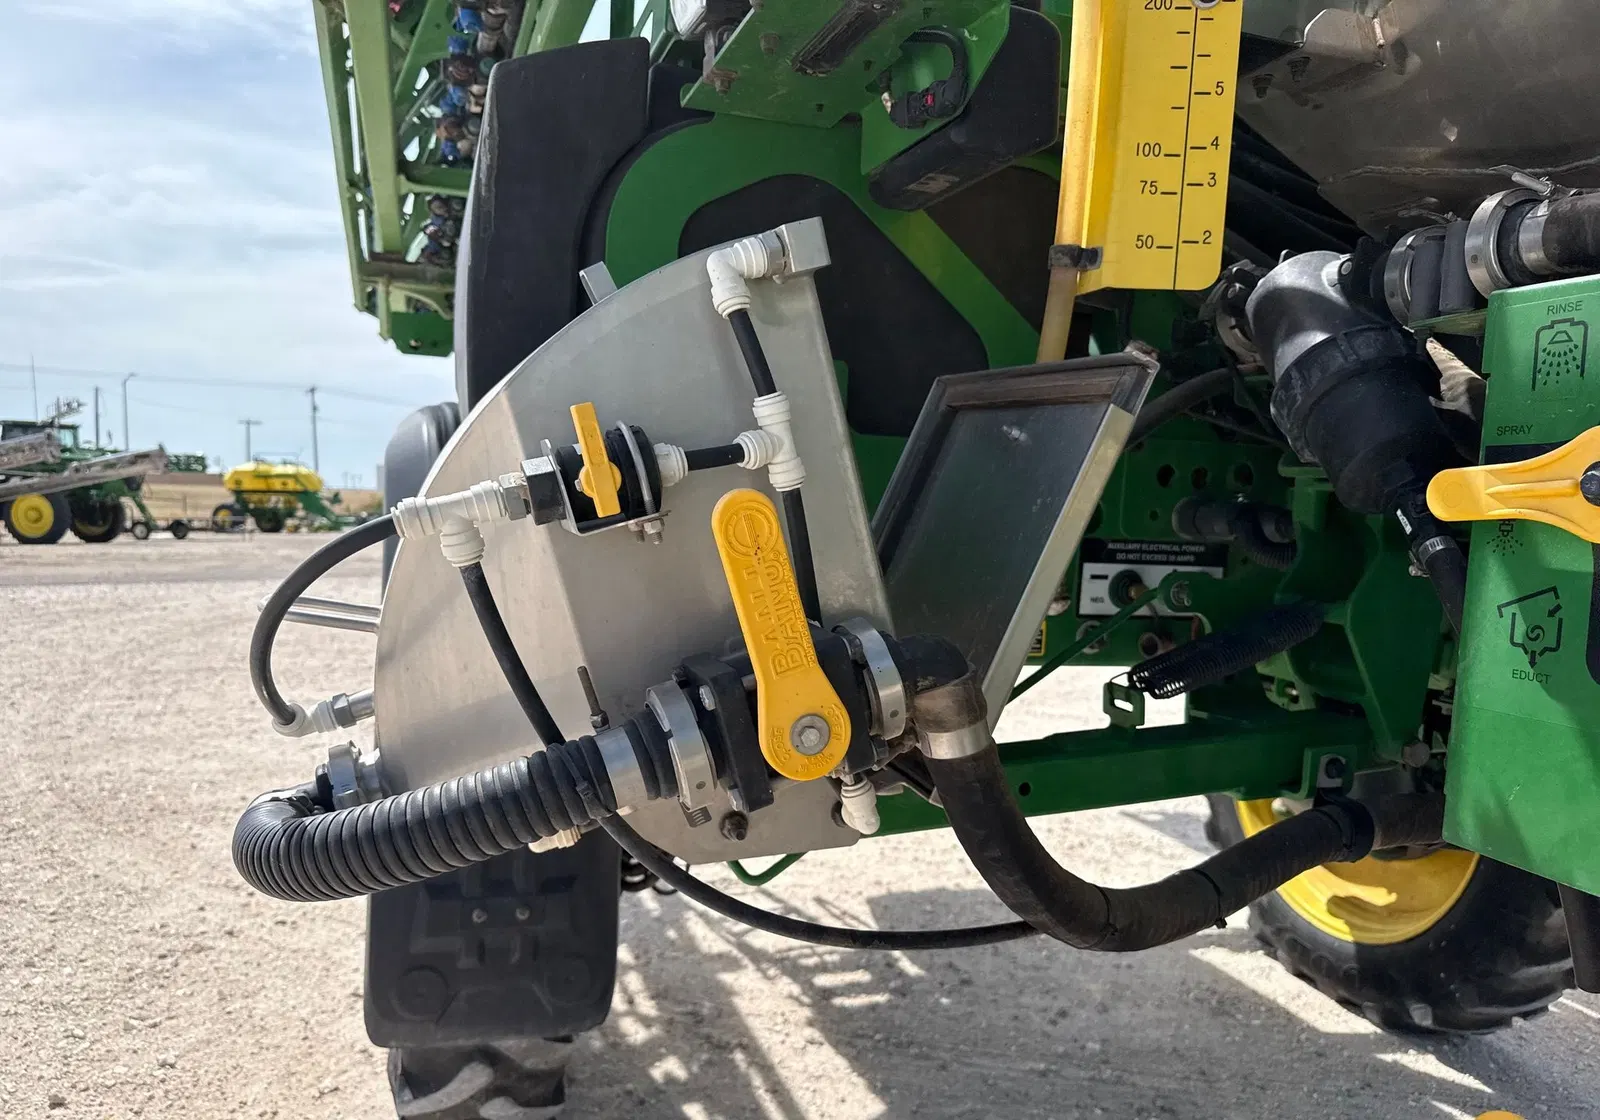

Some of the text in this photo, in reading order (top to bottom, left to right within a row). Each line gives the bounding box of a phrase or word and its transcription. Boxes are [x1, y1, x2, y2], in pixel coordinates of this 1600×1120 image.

[1145, 0, 1173, 10] 200
[1215, 81, 1224, 96] 5
[1136, 142, 1162, 157] 100
[1211, 136, 1220, 150] 4
[1207, 172, 1217, 187] 3
[1140, 180, 1158, 195] 75
[1135, 234, 1154, 249] 50
[1202, 230, 1212, 244] 2
[1546, 300, 1583, 316] RINSE
[1496, 424, 1533, 437] SPRAY
[1116, 552, 1126, 560] DO
[1511, 668, 1552, 684] EDUCT
[774, 727, 790, 762] CLOSE
